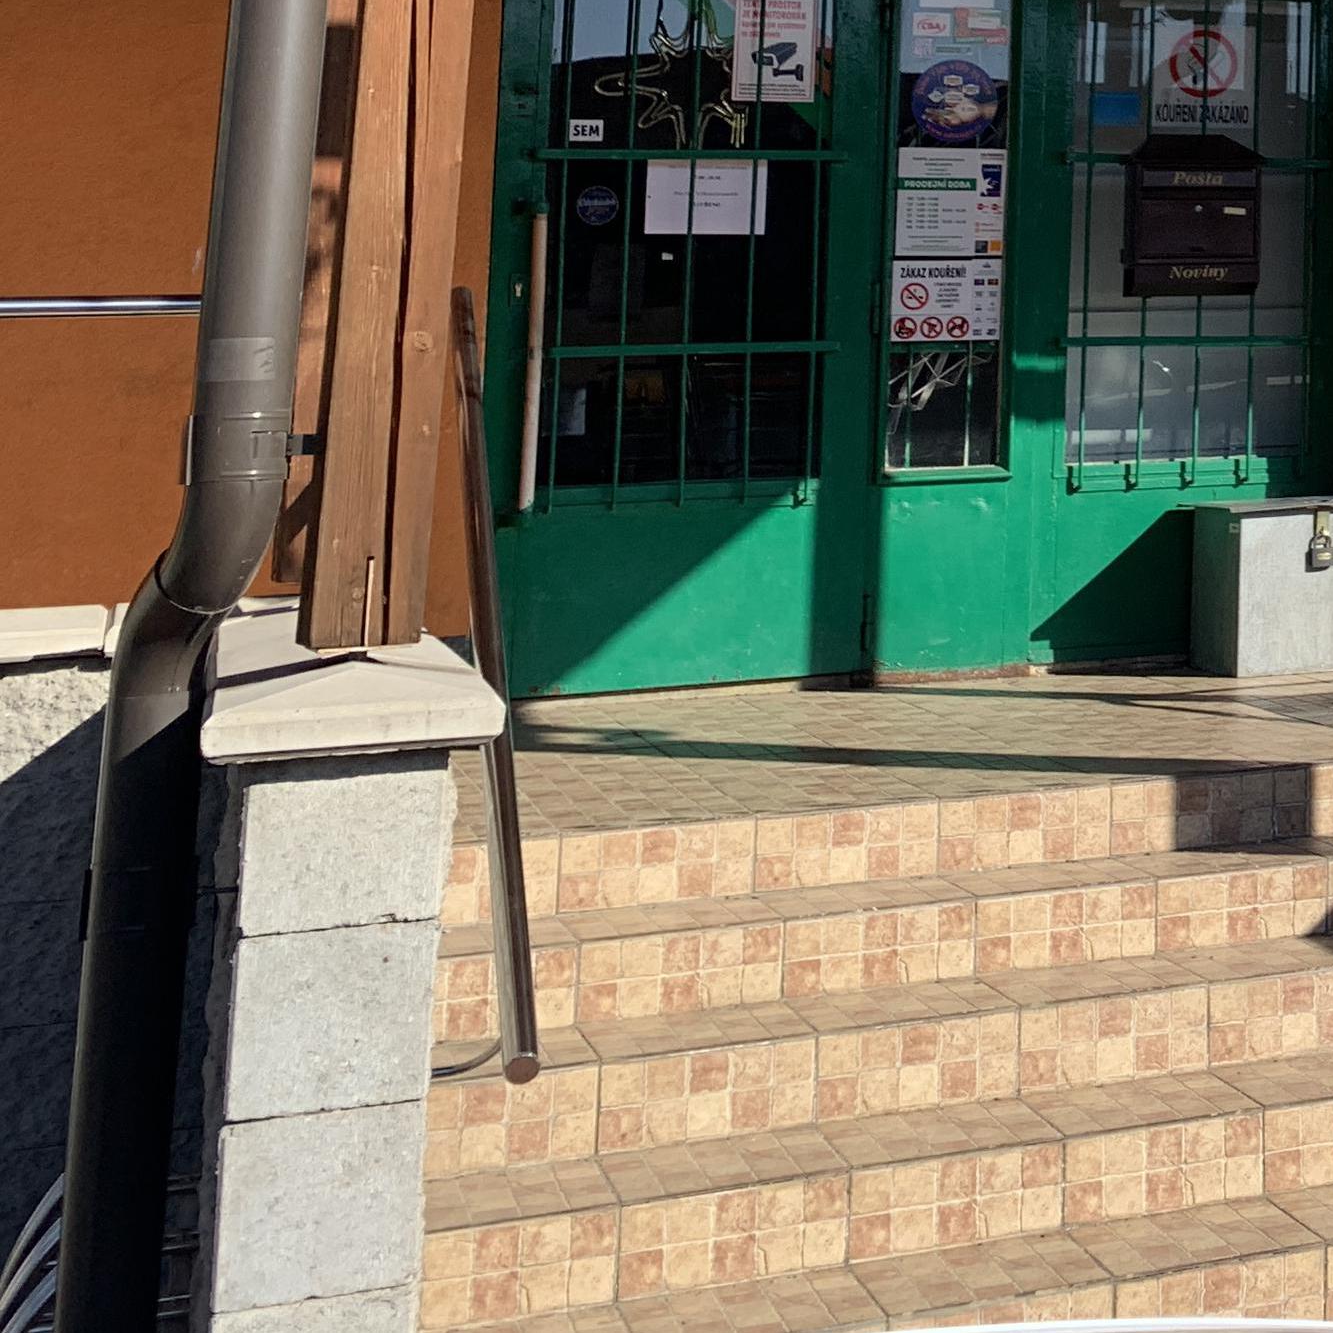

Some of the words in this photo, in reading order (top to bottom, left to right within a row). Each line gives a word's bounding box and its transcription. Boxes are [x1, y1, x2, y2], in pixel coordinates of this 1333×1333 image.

[1155, 98, 1197, 124] KOUŘENÍ
[573, 125, 600, 137] SEM
[904, 178, 947, 189] PRODEJNÍ
[948, 180, 972, 189] DOBA
[900, 265, 927, 279] ZÁKAZ
[1169, 265, 1229, 281] Noviny
